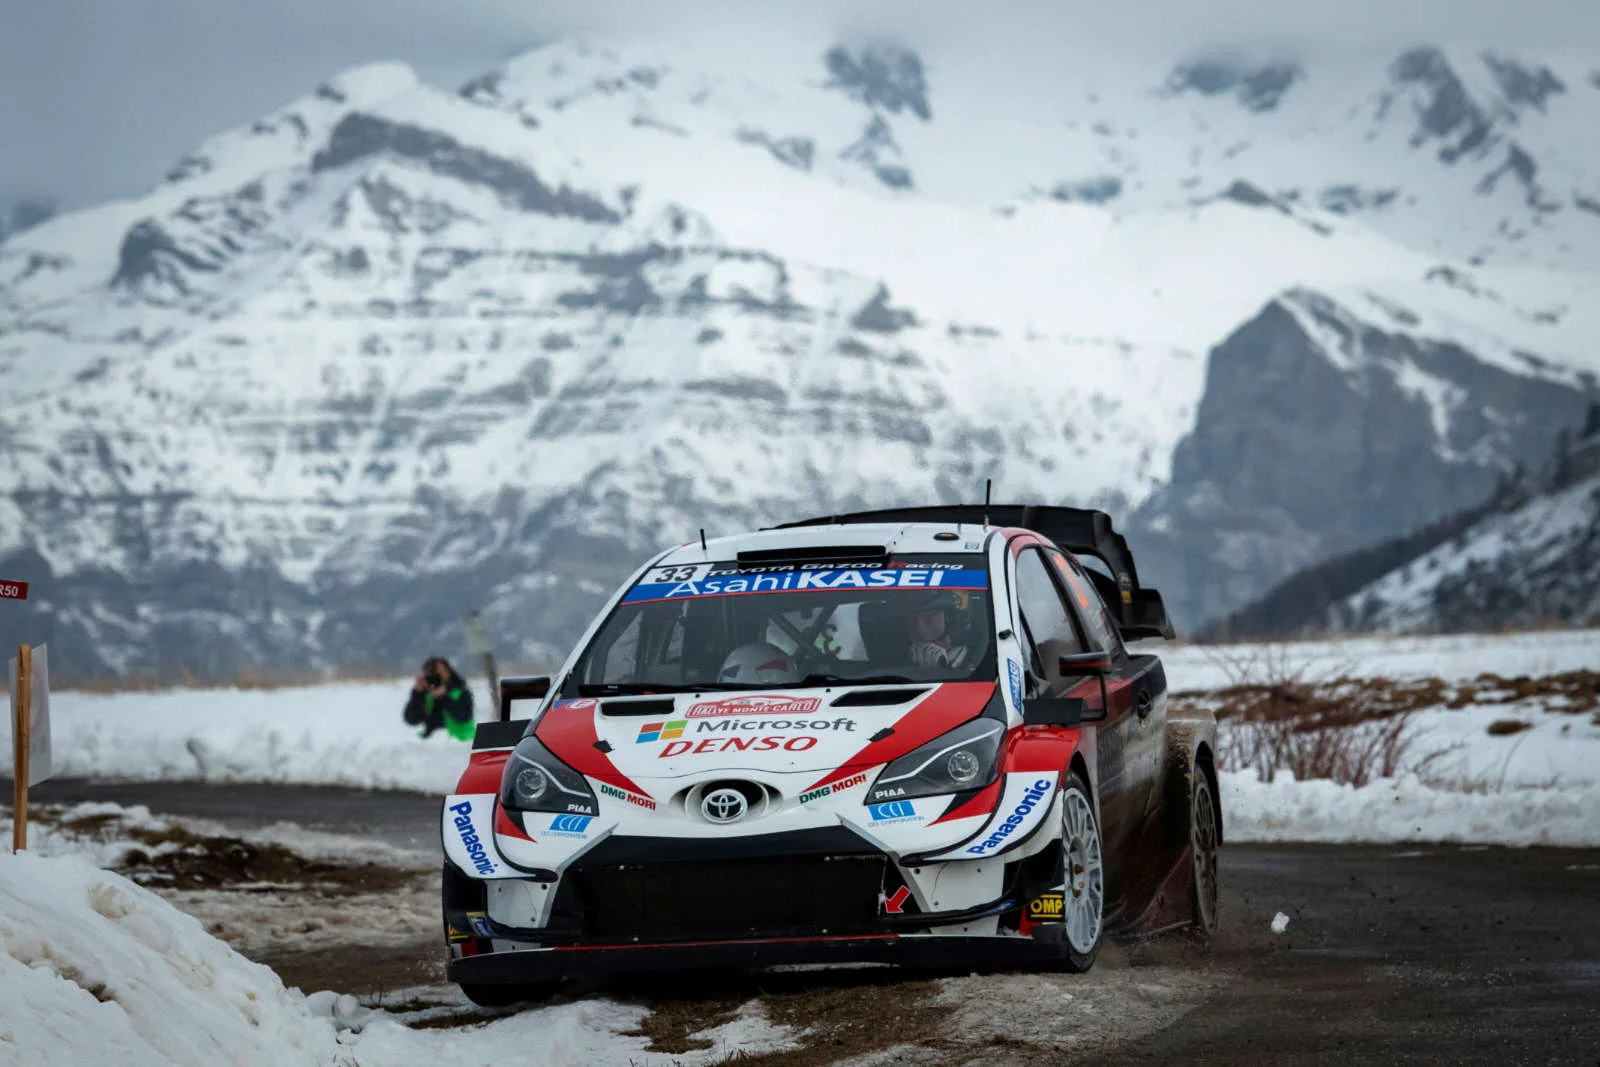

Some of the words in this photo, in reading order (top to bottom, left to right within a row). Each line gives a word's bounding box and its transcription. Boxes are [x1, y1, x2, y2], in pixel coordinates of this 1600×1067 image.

[655, 566, 698, 583] 33
[708, 565, 794, 577] TOYOTA
[800, 562, 883, 570] GAZOO
[887, 561, 964, 570] Racing
[692, 704, 729, 715] RALLYE
[732, 705, 769, 713] MONTE
[772, 700, 812, 712] CARLO
[697, 718, 857, 733] Microsoft
[658, 736, 818, 758] DENSO
[799, 787, 831, 804] DMG
[831, 774, 867, 793] MORI
[875, 787, 905, 799] PIAA
[600, 784, 626, 800] DMG
[626, 793, 656, 811] MORI
[567, 804, 592, 814] PIAA
[966, 779, 1051, 856] Panasonic
[449, 801, 499, 876] Panasonic
[1030, 898, 1063, 913] OMP
